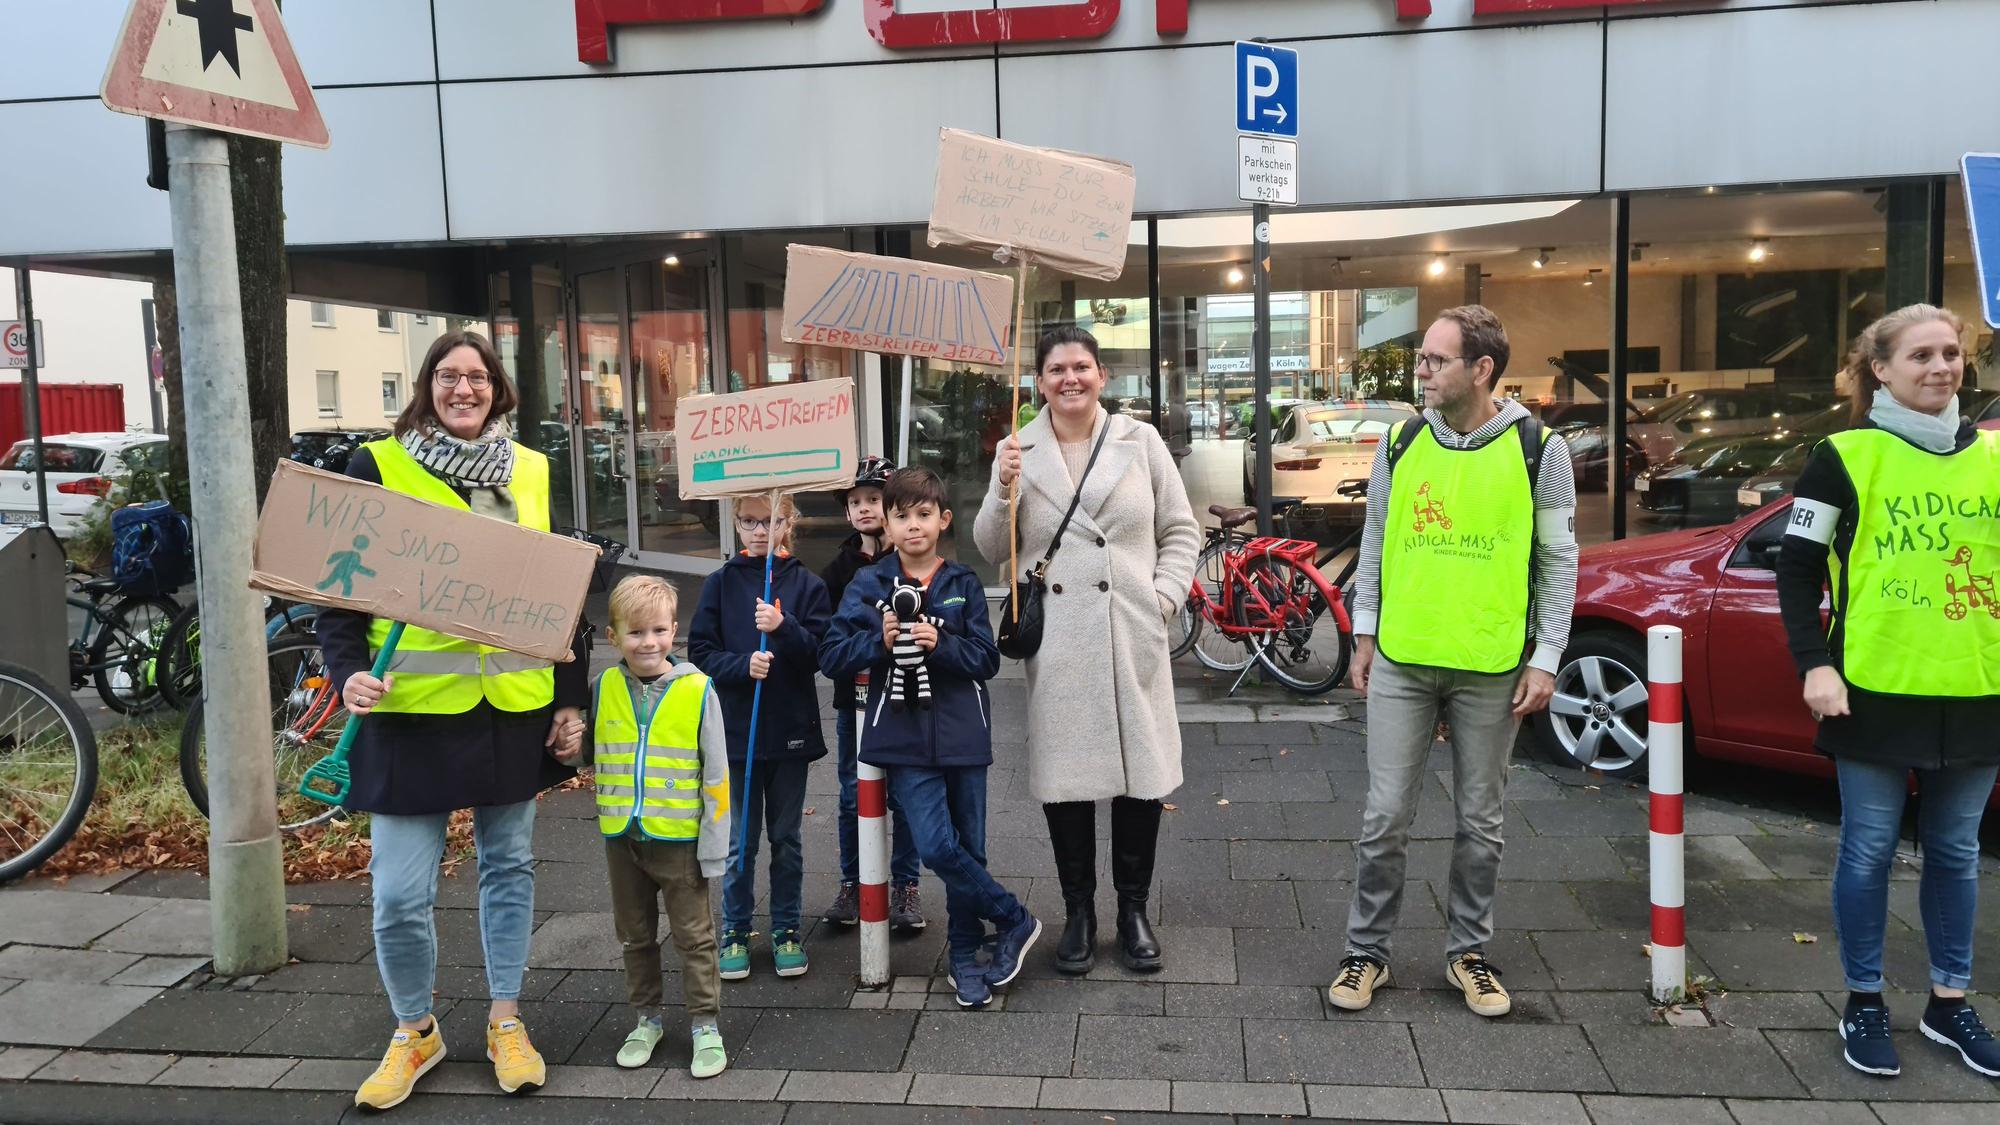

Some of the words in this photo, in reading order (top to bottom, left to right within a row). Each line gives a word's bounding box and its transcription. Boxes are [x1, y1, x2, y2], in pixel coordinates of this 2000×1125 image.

[1246, 54, 1280, 121] P
[1244, 155, 1292, 171] Parkschein
[1261, 143, 1276, 155] mit
[960, 144, 992, 163] ICH
[998, 152, 1044, 177] MUSS
[1058, 164, 1106, 190] ZUR
[1248, 172, 1289, 186] werktags
[1052, 182, 1084, 201] DU
[1095, 194, 1126, 216] ZUR
[1257, 186, 1280, 200] 9-21h
[955, 185, 1025, 209] ARBEIT
[1030, 199, 1058, 218] WIR
[1065, 208, 1124, 234] SITZEN
[977, 213, 1001, 233] IM
[1012, 217, 1072, 244] SELBEN
[801, 324, 940, 353] ZEBRASTREIFEN
[9, 357, 28, 366] ZON
[1276, 358, 1295, 368] Köln
[687, 392, 850, 441] ZEBRASTREIFEN
[385, 528, 460, 566] SIND
[1403, 533, 1455, 553] KIDICAL
[1459, 533, 1496, 552] MASS
[1433, 549, 1458, 557] KINDER
[1458, 550, 1477, 559] AUFS
[1477, 553, 1492, 561] RAD
[1874, 521, 1951, 560] MASS
[417, 569, 568, 633] VERKEHR
[1880, 577, 1932, 608] Köln
